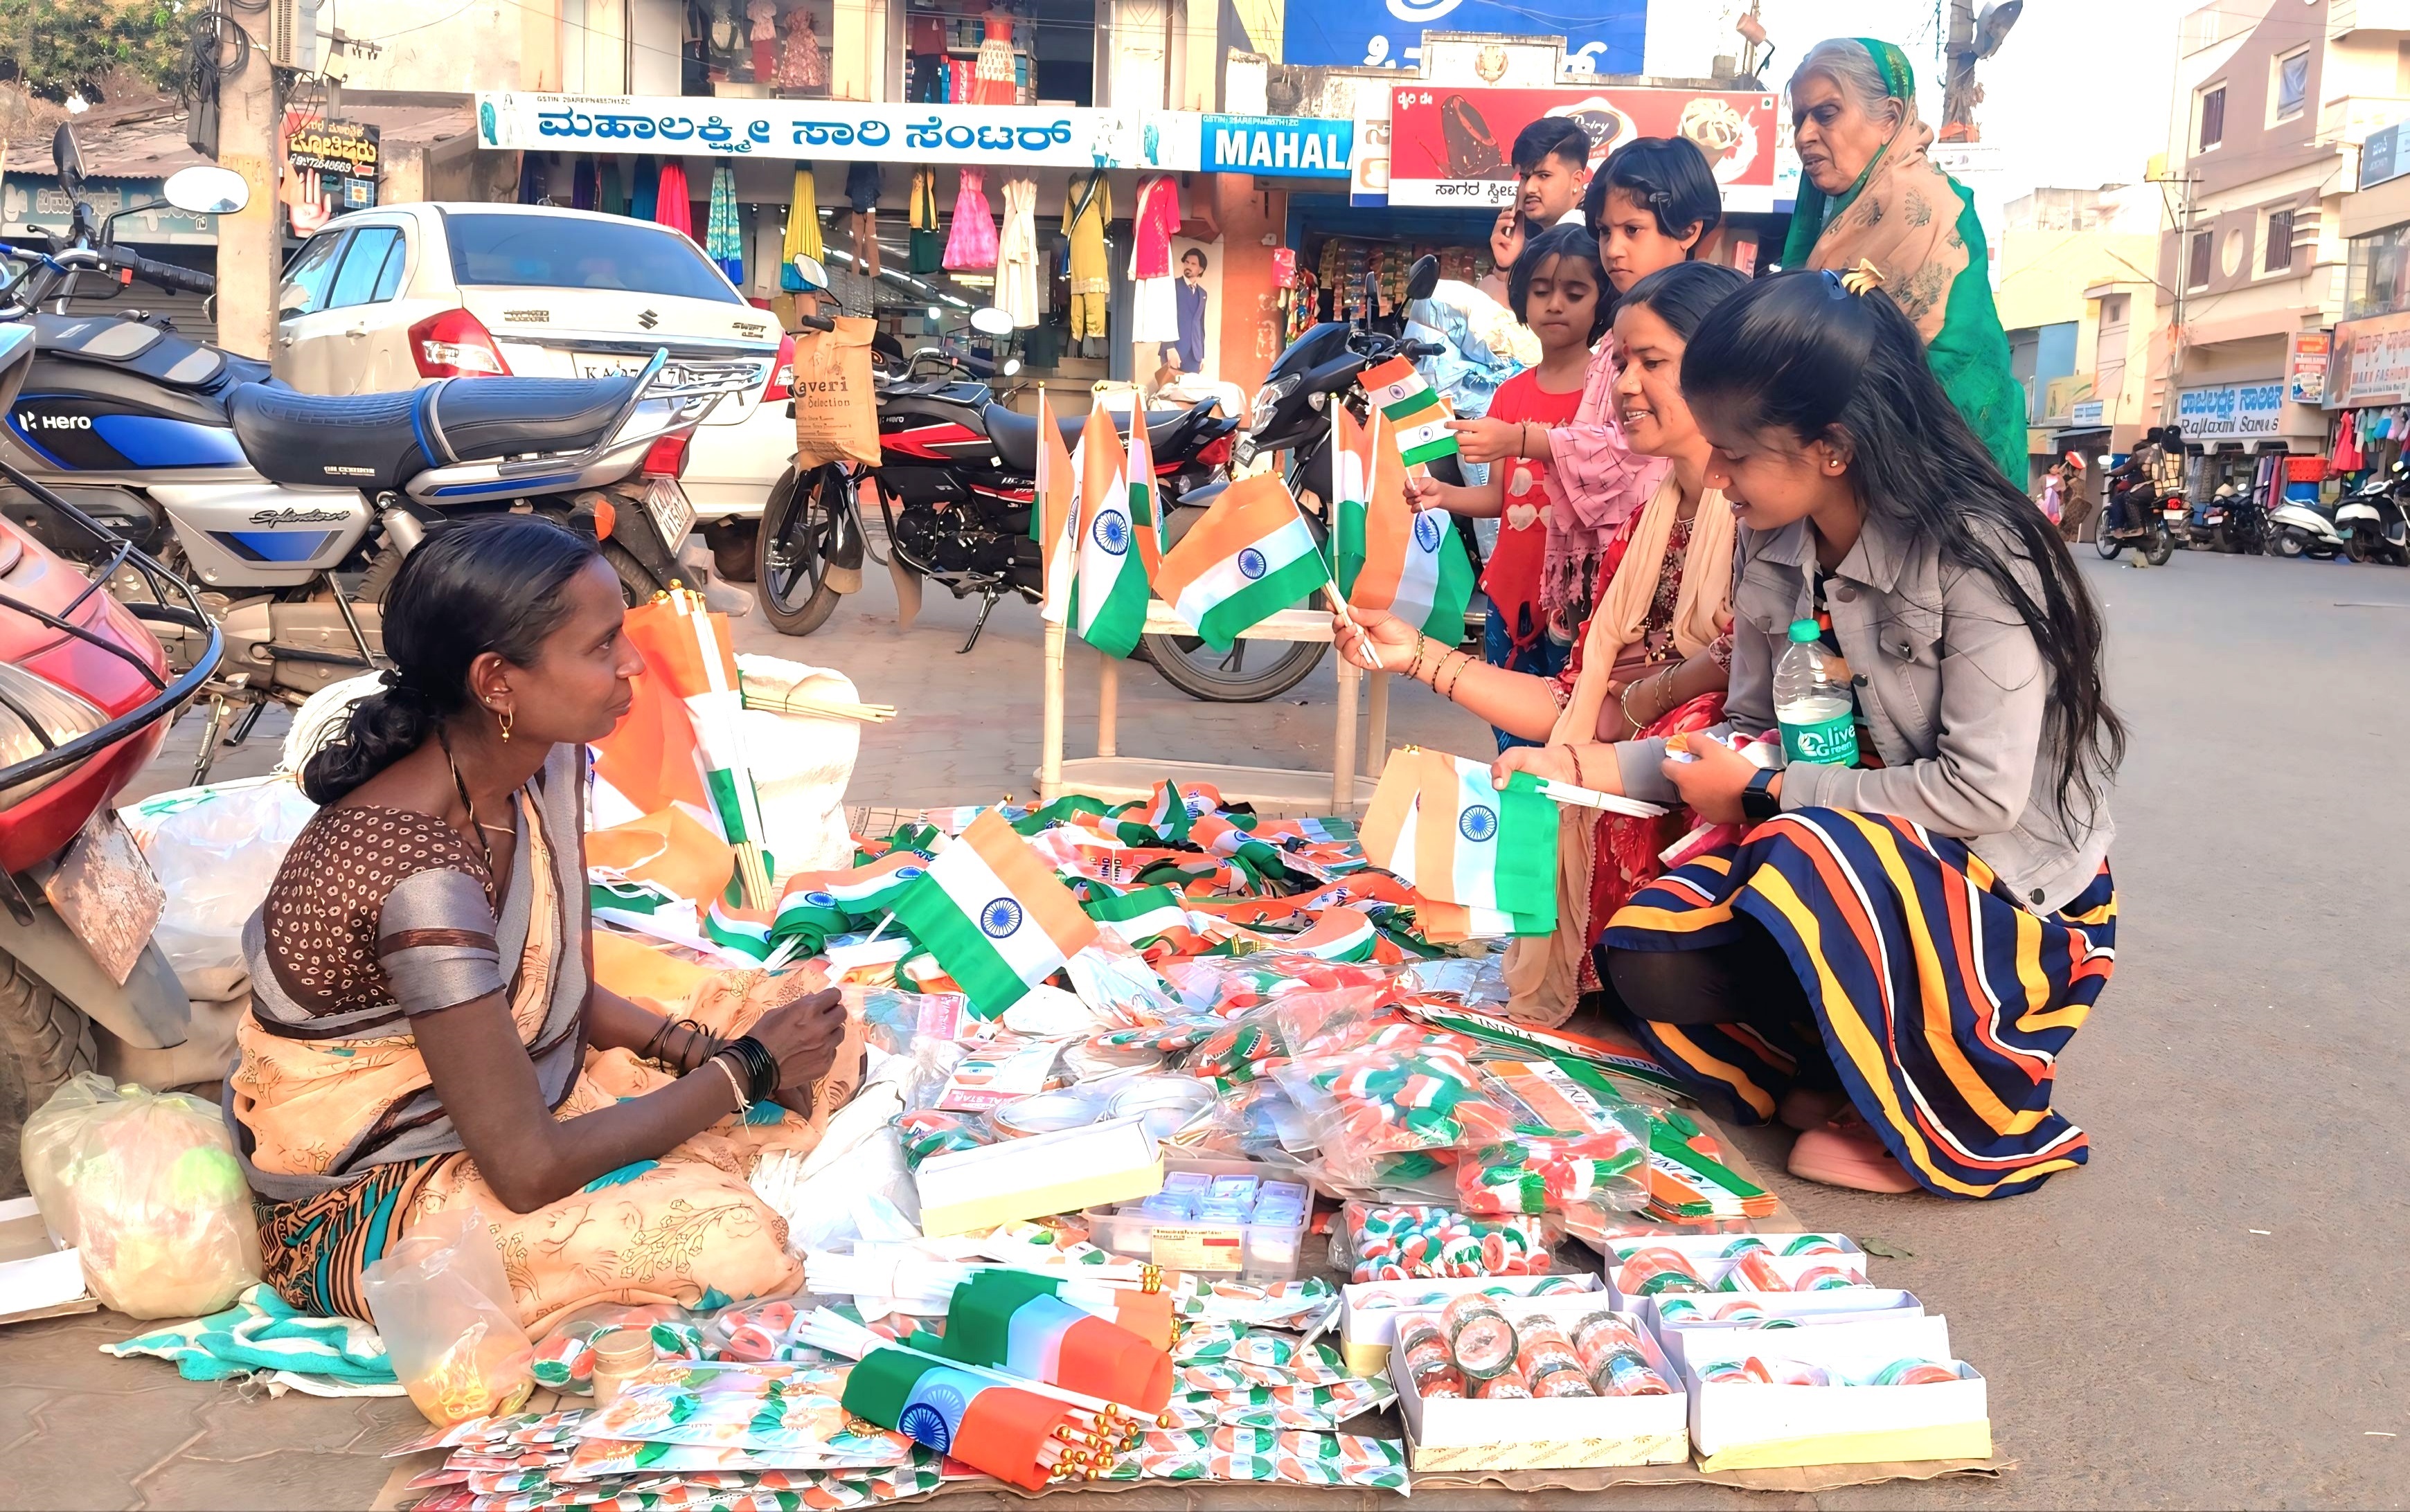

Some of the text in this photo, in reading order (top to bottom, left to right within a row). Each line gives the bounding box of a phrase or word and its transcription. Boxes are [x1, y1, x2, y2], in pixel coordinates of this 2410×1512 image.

[792, 118, 891, 148] ಸಾರಿ
[906, 116, 1071, 151] ಸೆಂಟರ್
[1436, 181, 1480, 196] ಸಾಗರ
[42, 416, 91, 429] Hero
[1817, 741, 1853, 757] Green
